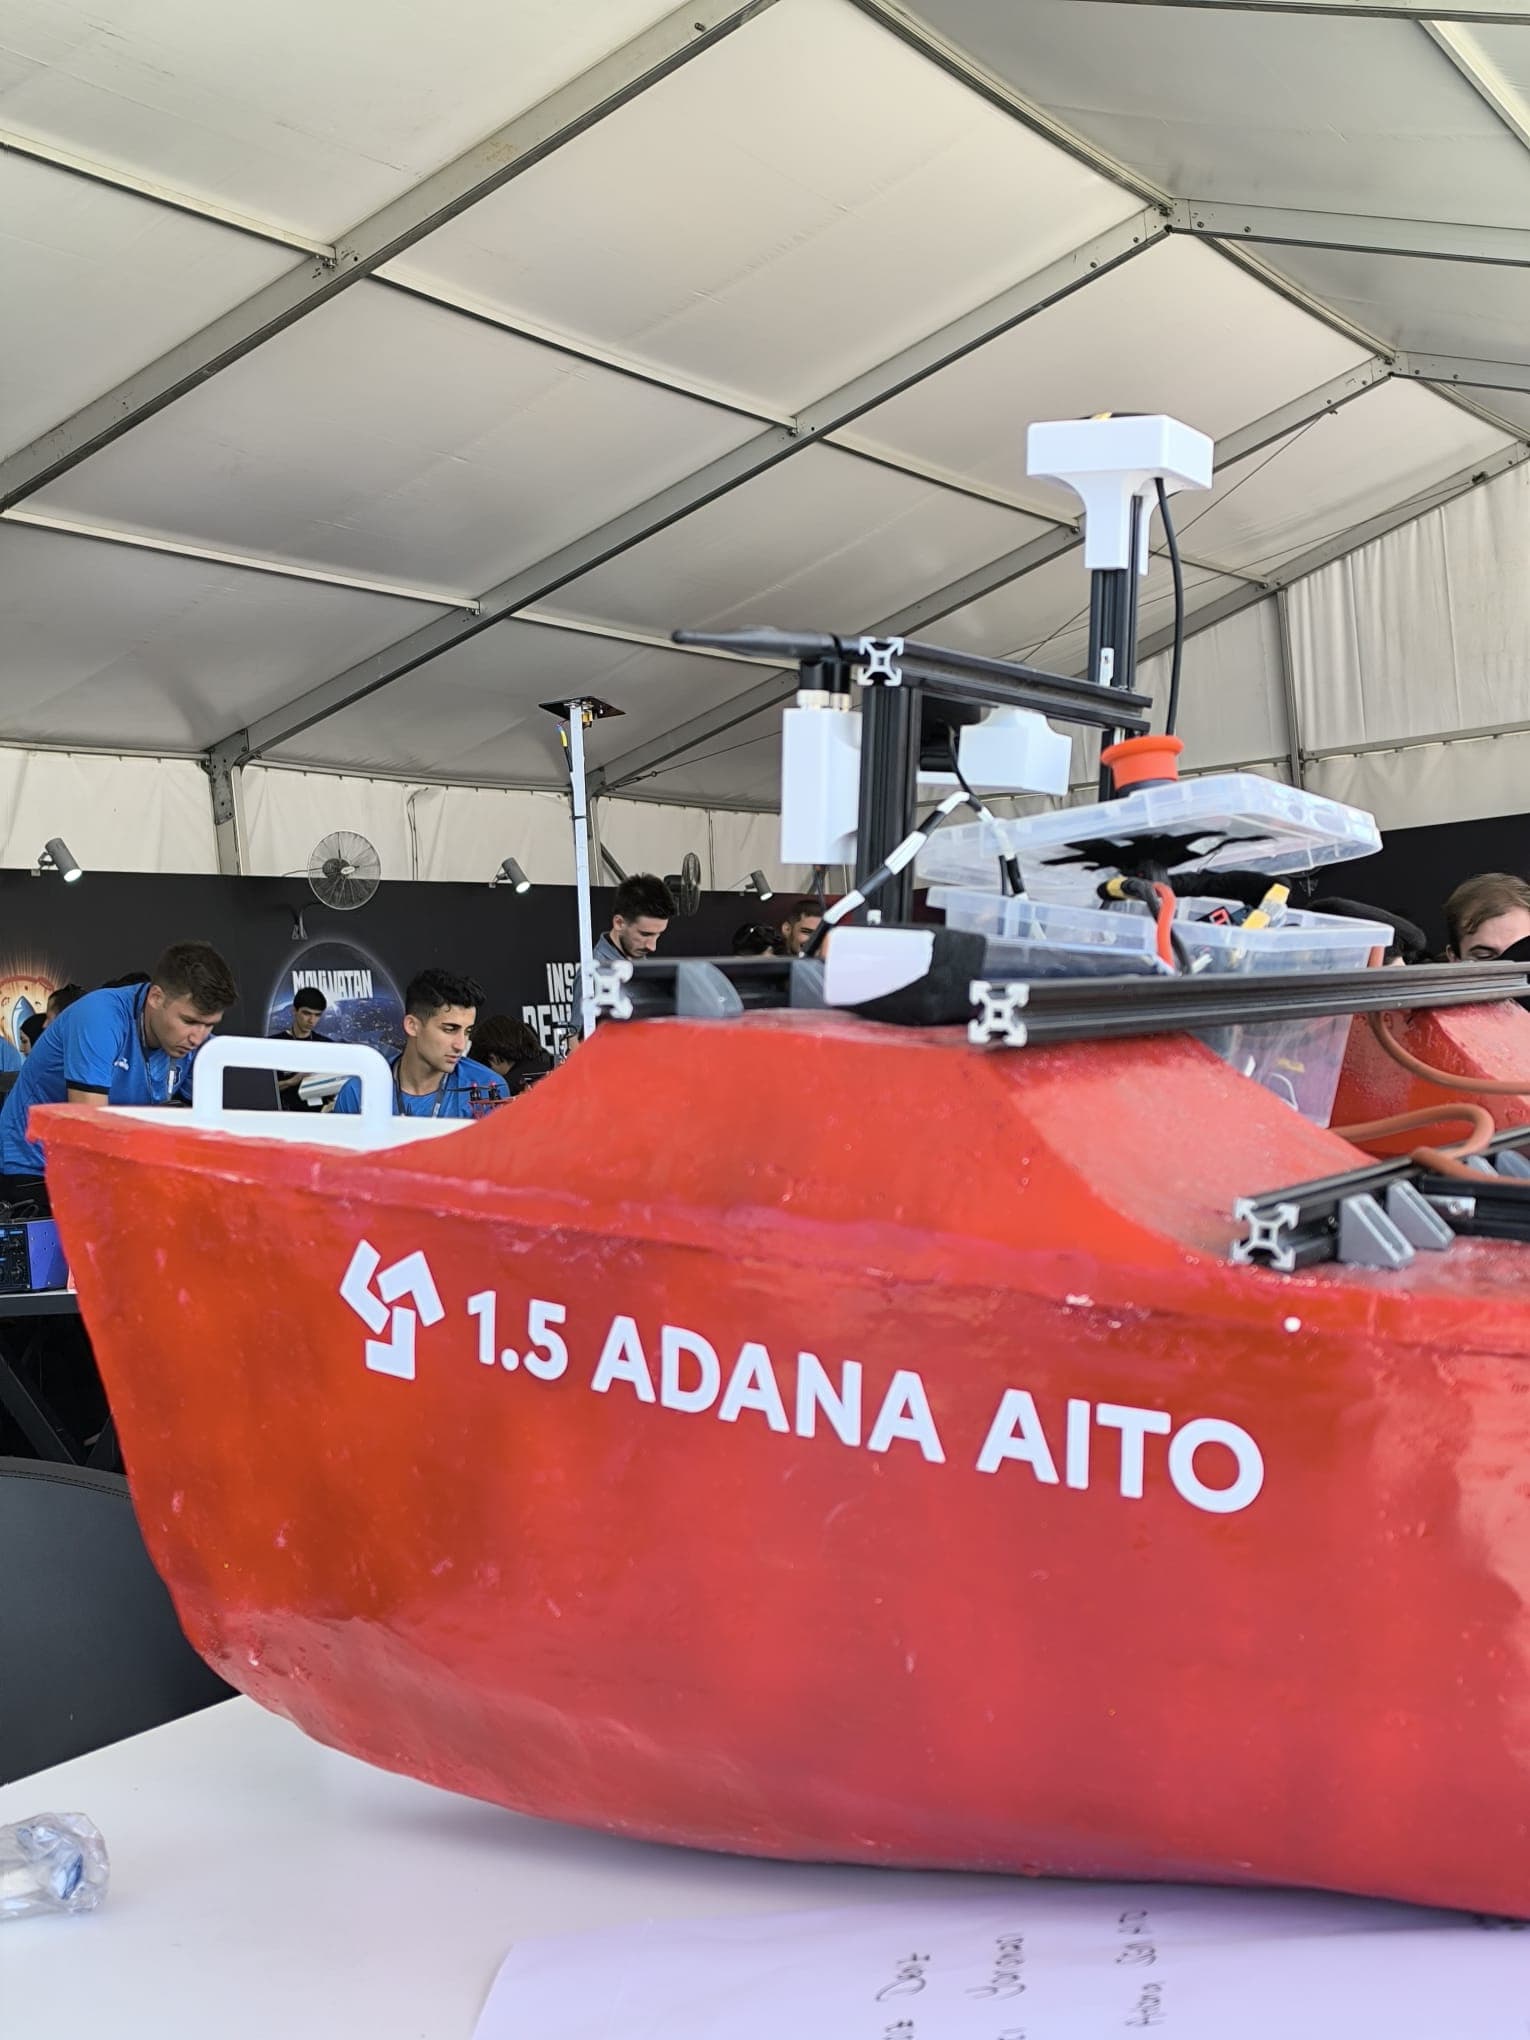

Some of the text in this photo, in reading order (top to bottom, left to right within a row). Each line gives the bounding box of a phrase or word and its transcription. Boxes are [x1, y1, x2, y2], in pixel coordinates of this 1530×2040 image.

[467, 1290, 1265, 1513] 1.5 ADANA AITO
